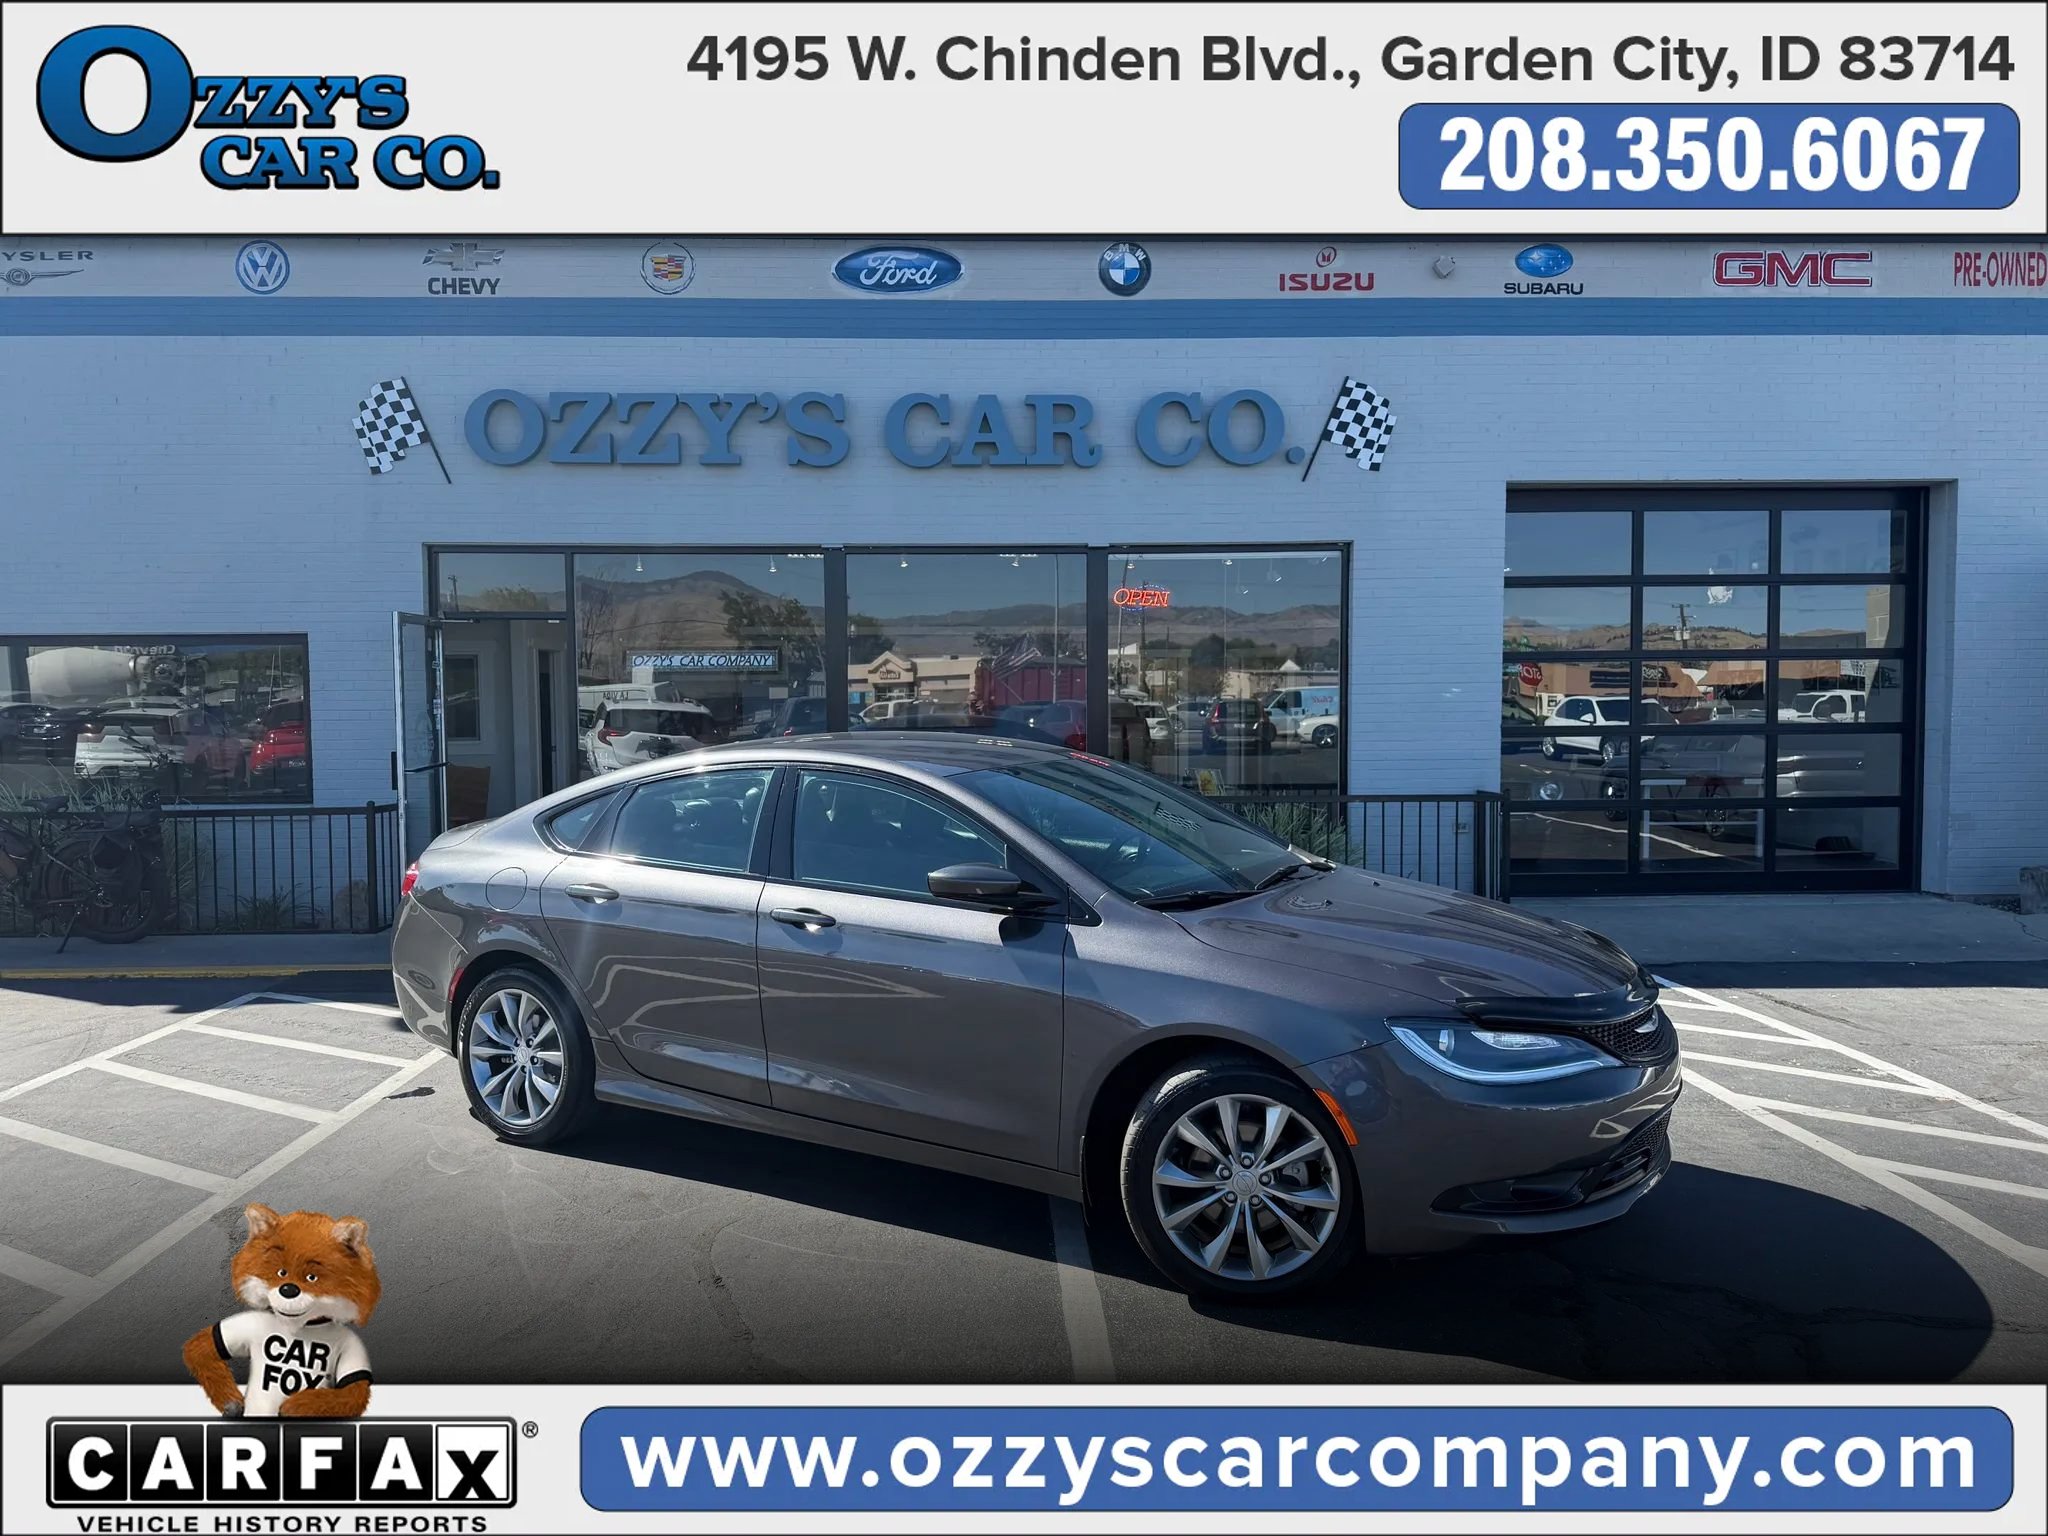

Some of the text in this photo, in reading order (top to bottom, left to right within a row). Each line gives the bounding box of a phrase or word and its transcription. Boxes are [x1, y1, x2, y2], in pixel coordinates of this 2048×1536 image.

[1104, 244, 1146, 261] BMW
[860, 251, 938, 285] Ford
[1714, 250, 1872, 287] GMC
[1954, 251, 2047, 287] PRE-OWNED
[427, 277, 500, 295] CHEVY
[1279, 272, 1374, 292] ISUZU
[1504, 282, 1584, 295] SUBARU
[464, 388, 1306, 467] OZZY'S CAR CO.
[1113, 588, 1170, 607] OPEN
[633, 655, 773, 667] OZZY'S CAR COMPANY
